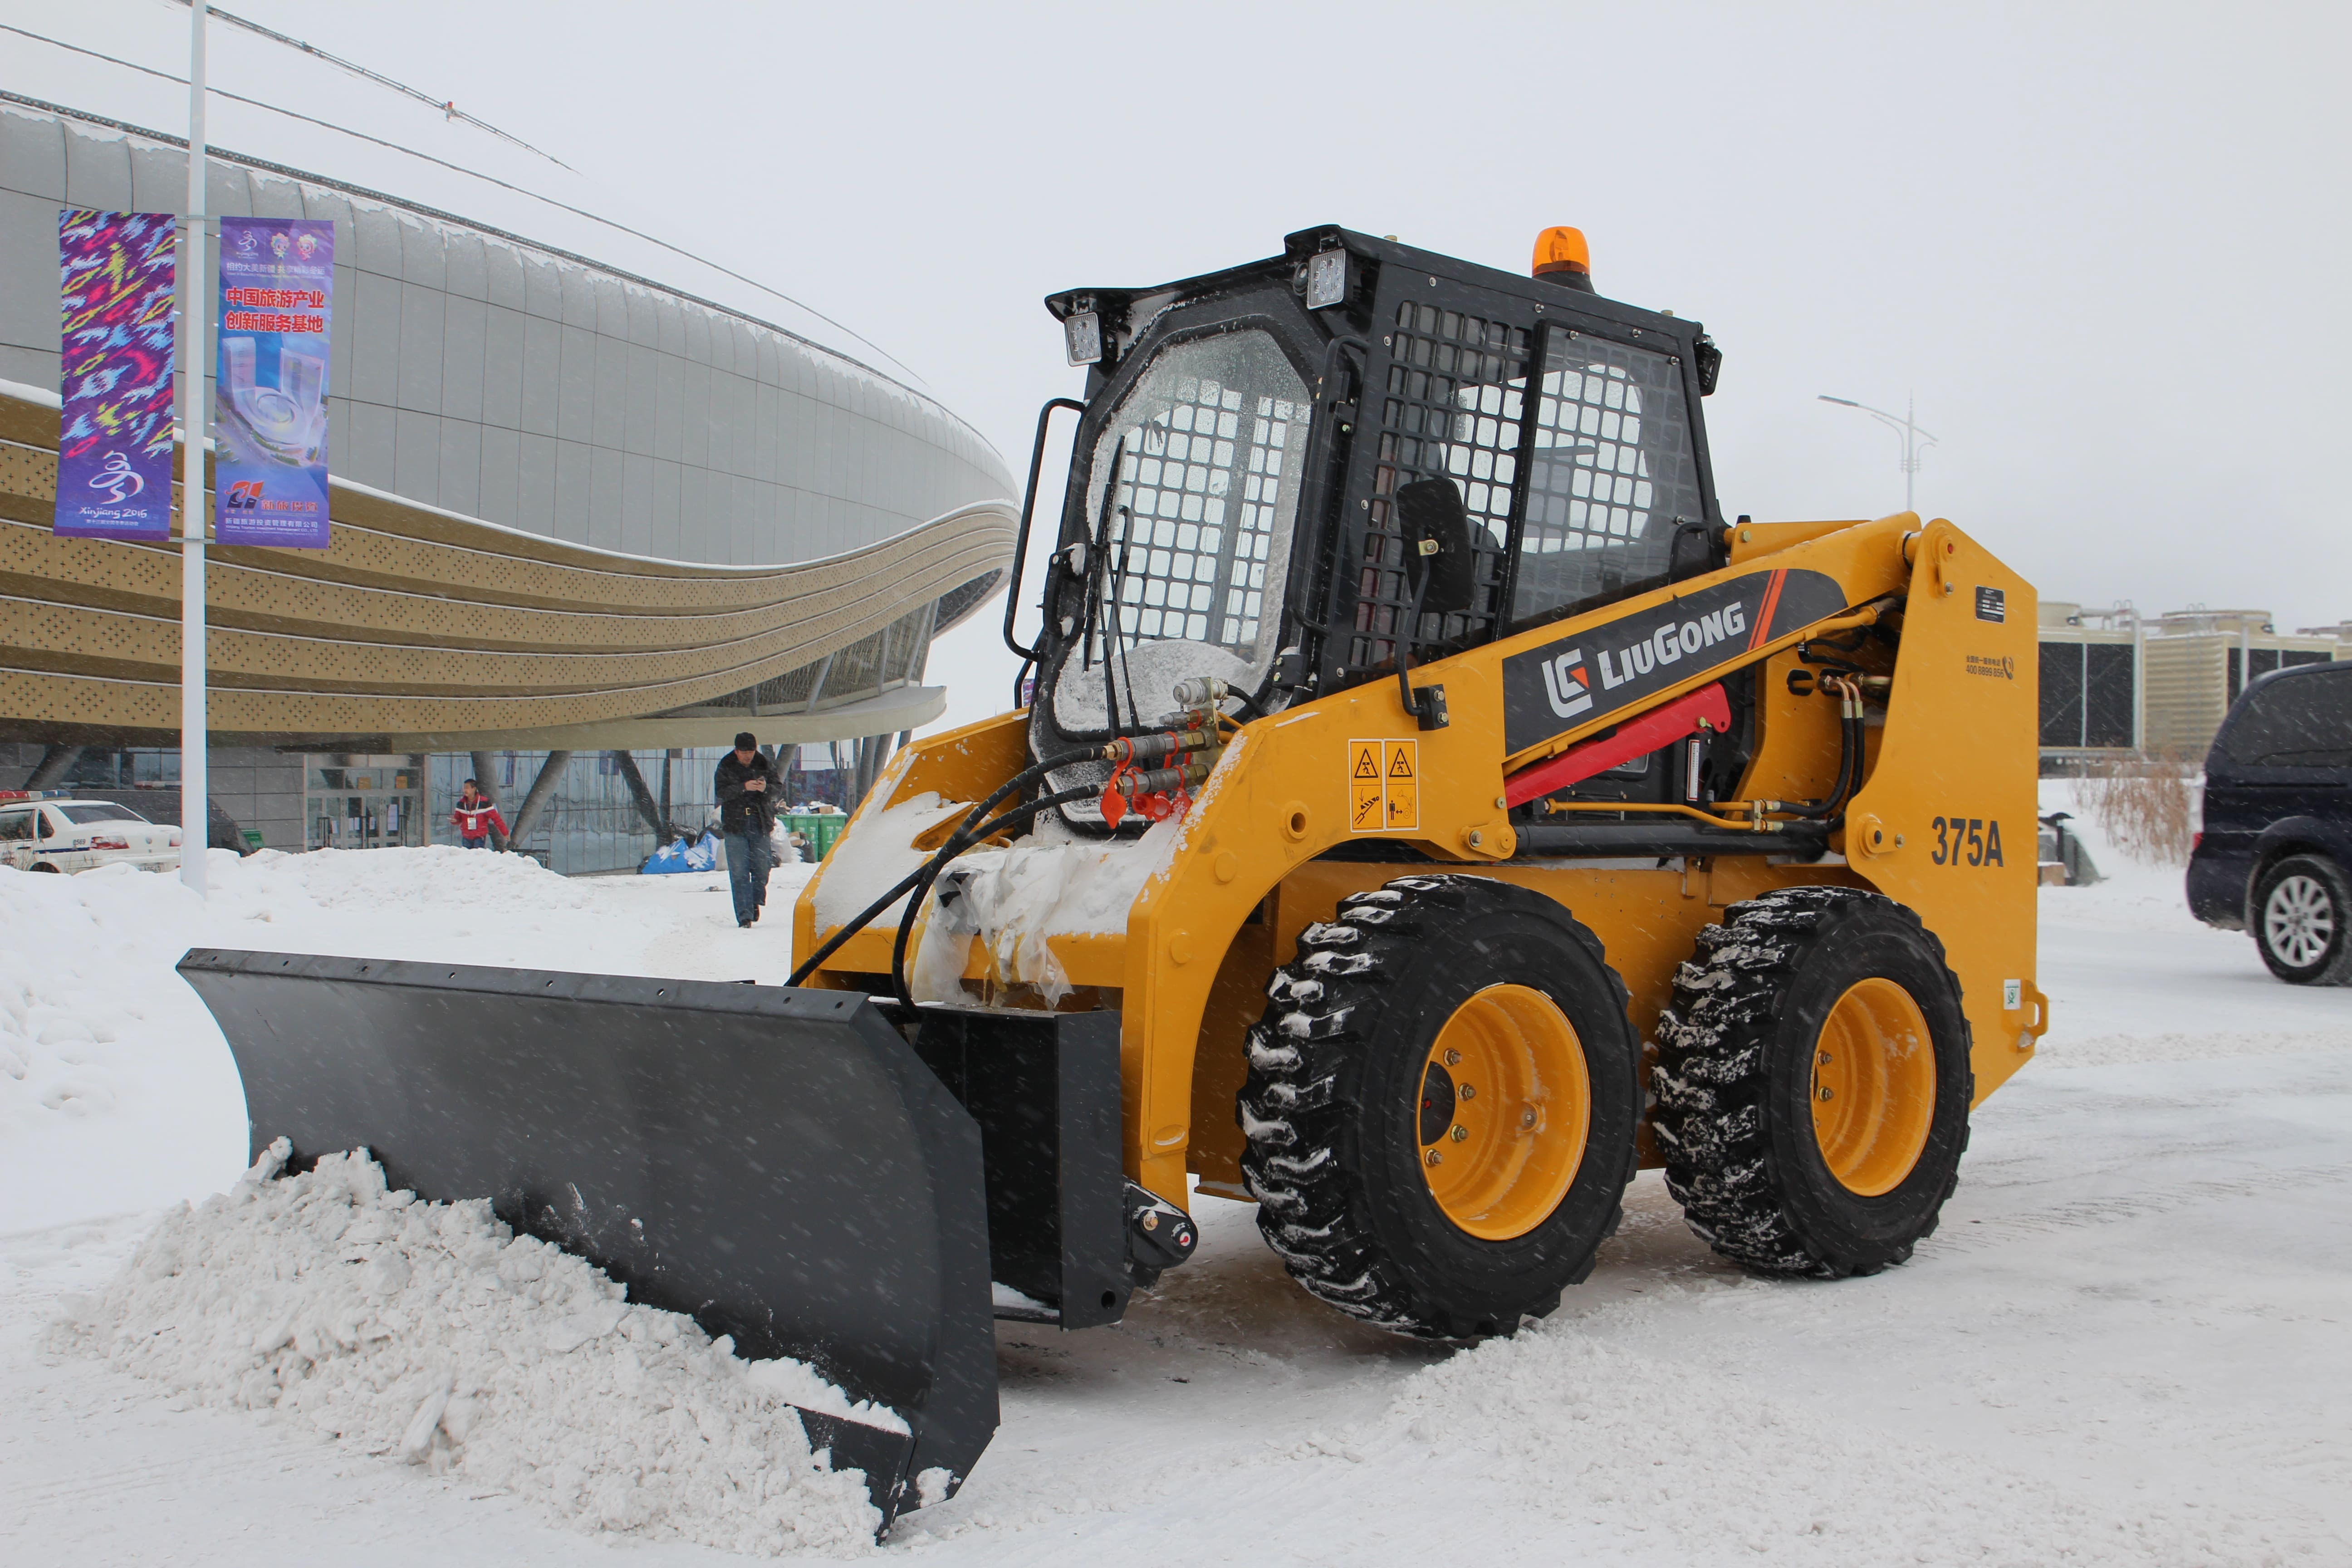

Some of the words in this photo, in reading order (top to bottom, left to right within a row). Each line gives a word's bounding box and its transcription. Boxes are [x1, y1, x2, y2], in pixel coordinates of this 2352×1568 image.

[226, 286, 325, 309] 中国旅游产业
[225, 311, 323, 333] 创新服务基地
[79, 507, 121, 519] Xinjiang
[1966, 665, 1977, 674] 400
[1978, 666, 1992, 676] 8899
[1931, 816, 2004, 867] 375A
